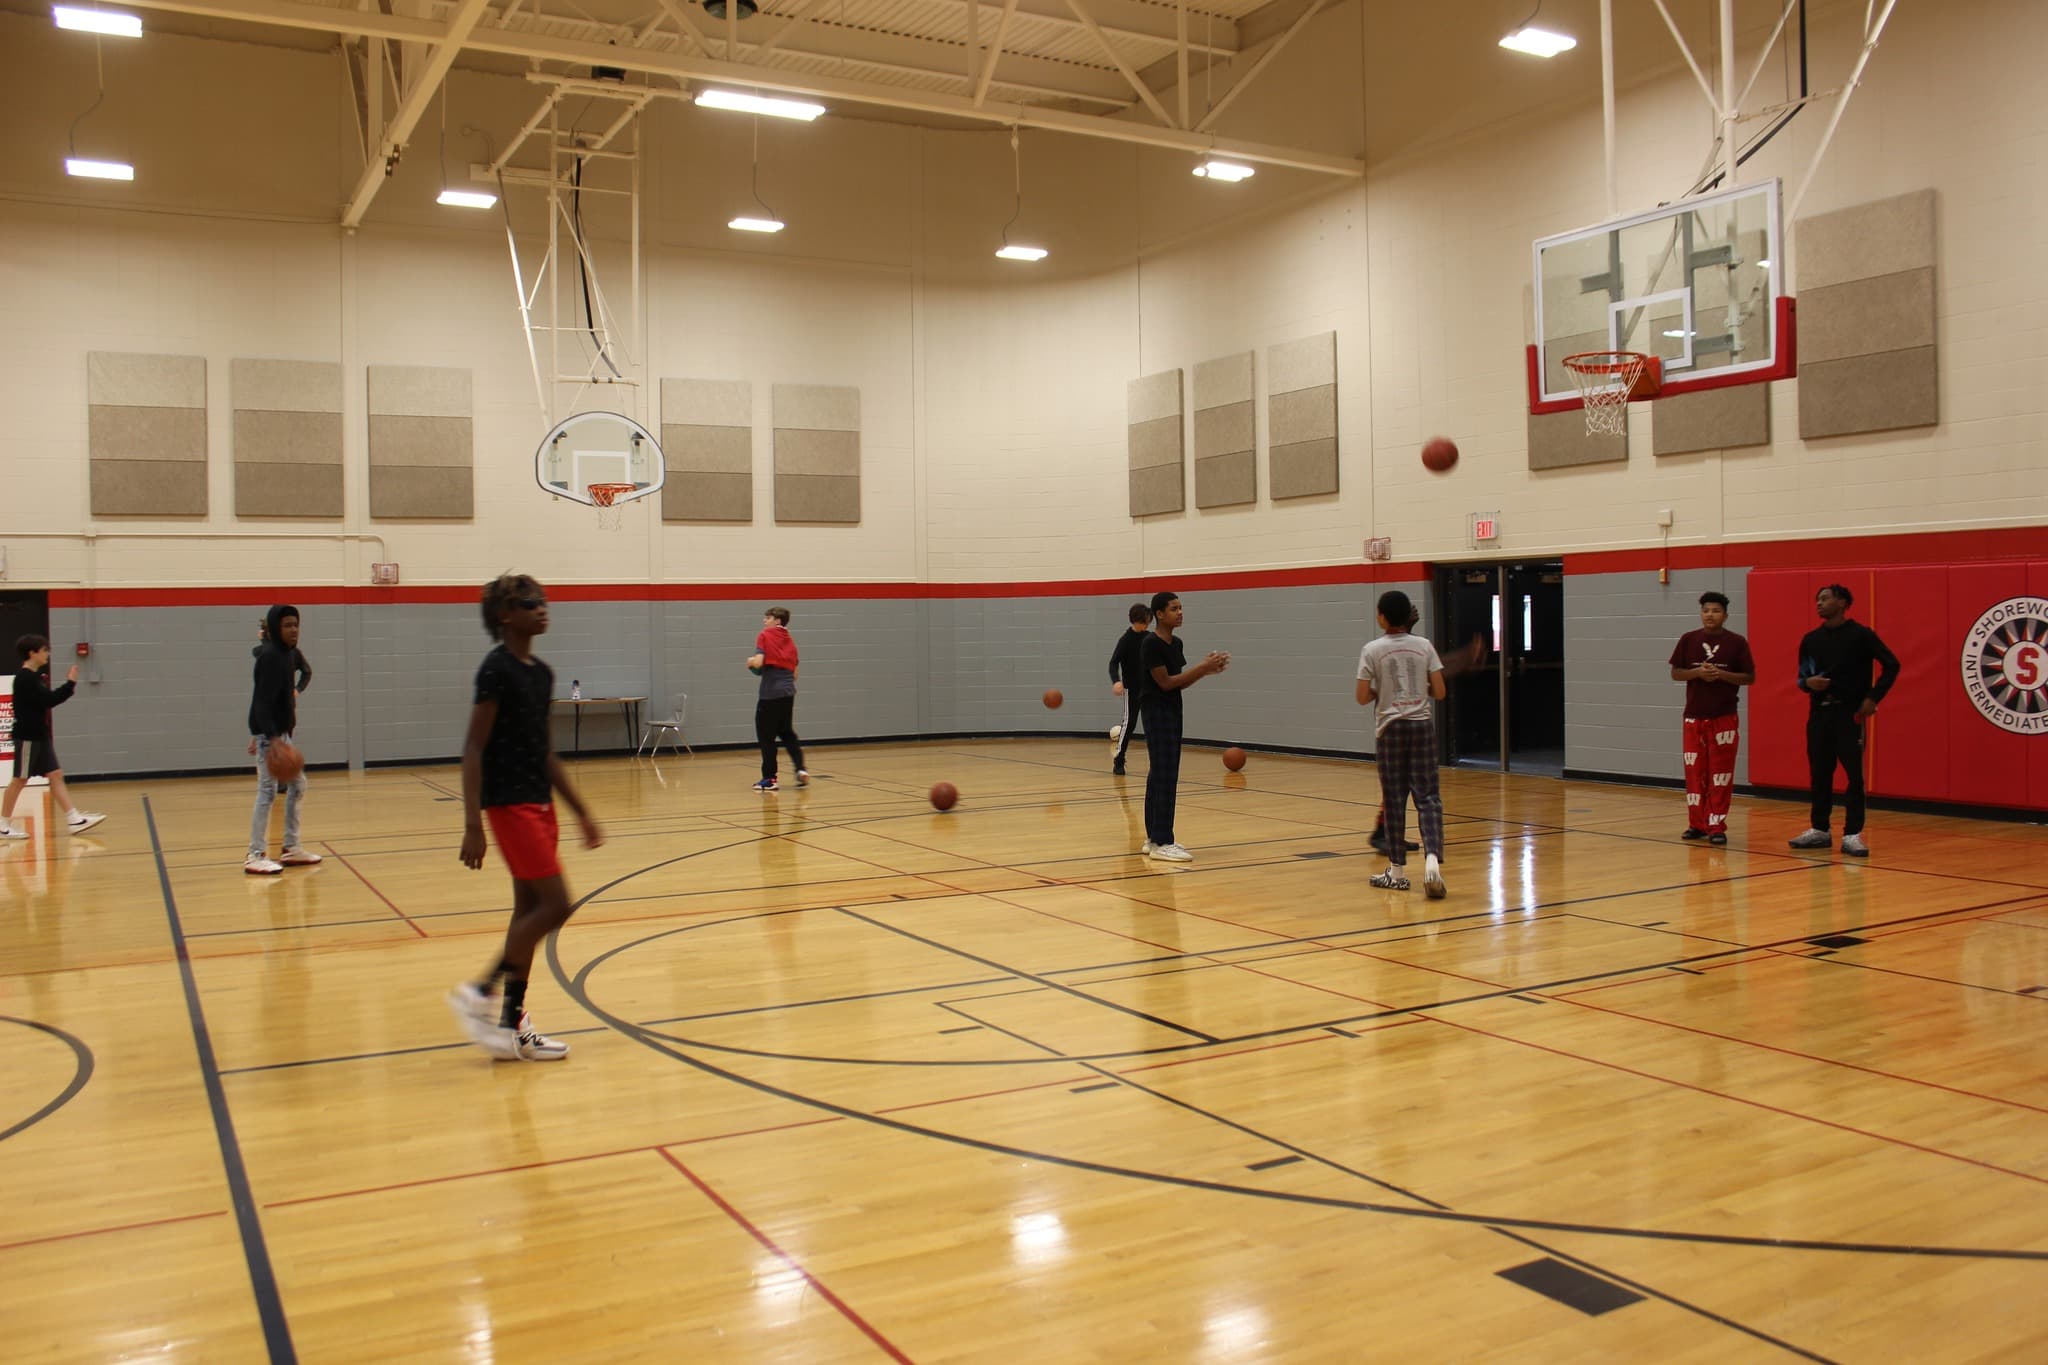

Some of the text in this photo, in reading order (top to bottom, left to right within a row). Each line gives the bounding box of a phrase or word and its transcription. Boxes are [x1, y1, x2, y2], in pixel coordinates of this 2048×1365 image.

[1477, 521, 1493, 537] EXIT
[2015, 647, 2040, 685] S
[1966, 654, 2048, 729] INTERMEDIATE
[1716, 730, 1735, 745] W
[1684, 752, 1698, 766] W
[1713, 773, 1732, 786] W
[1686, 793, 1700, 806] W
